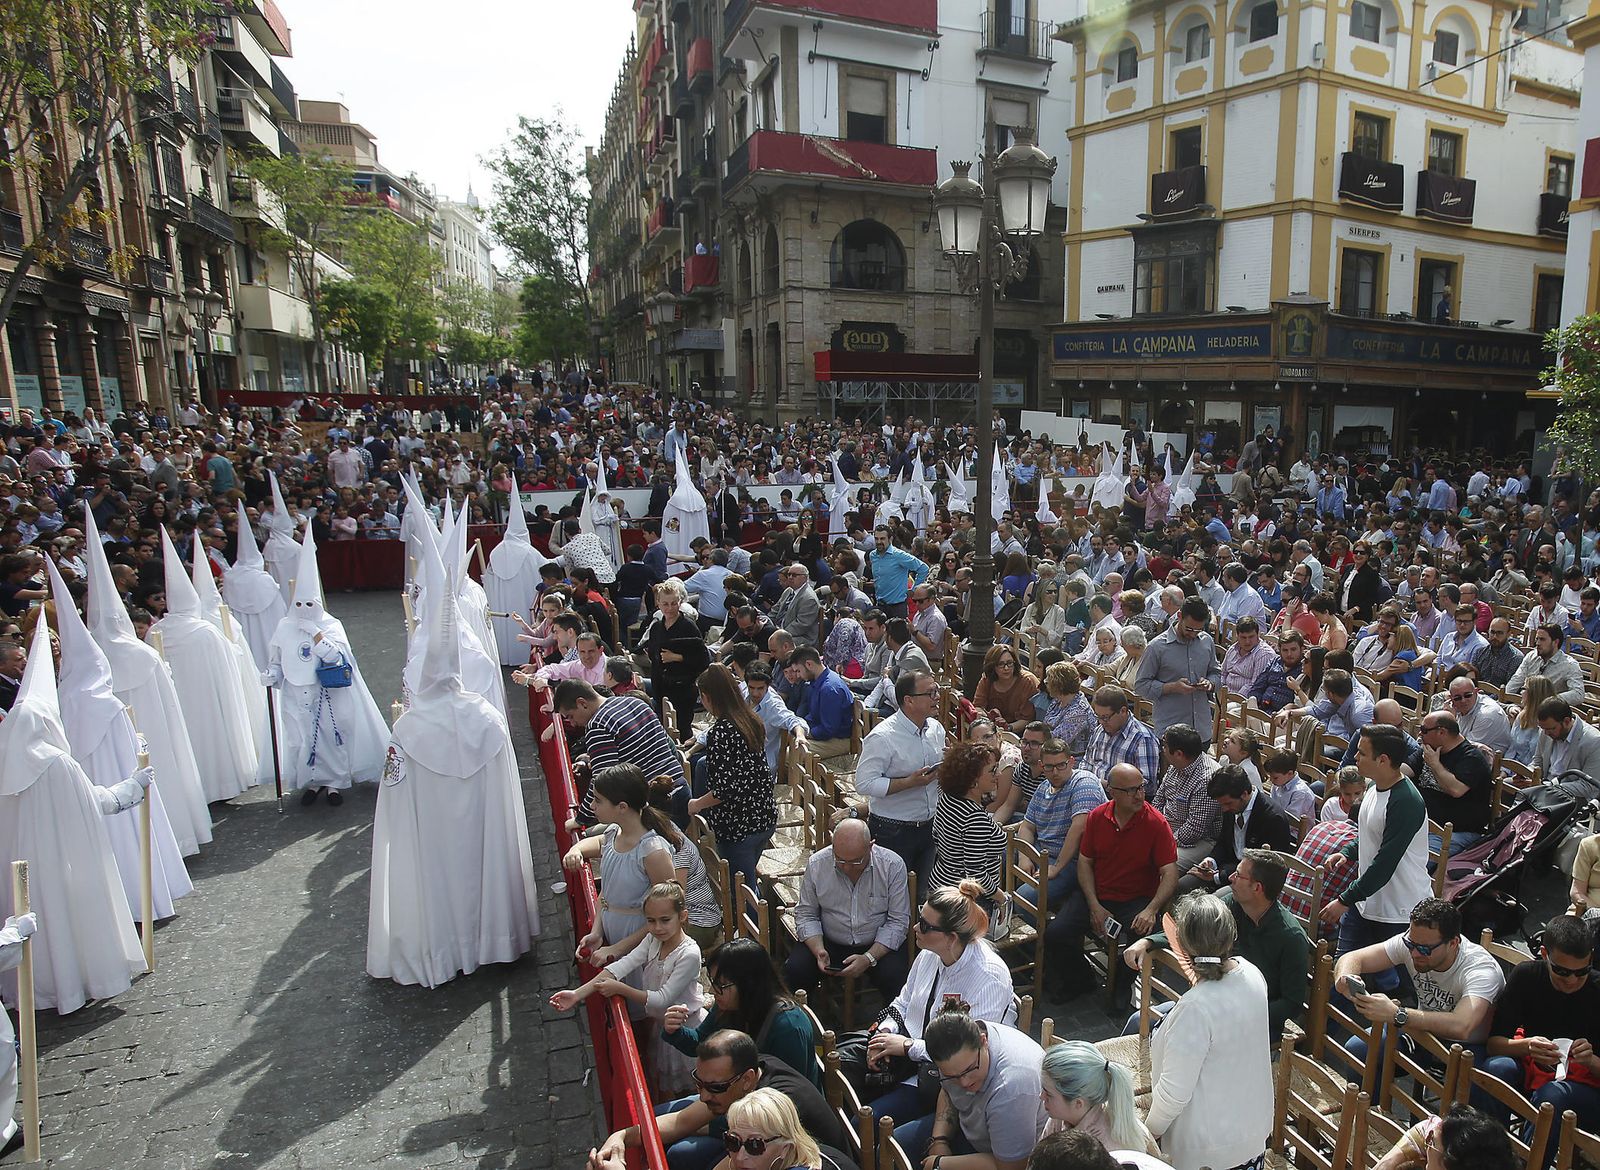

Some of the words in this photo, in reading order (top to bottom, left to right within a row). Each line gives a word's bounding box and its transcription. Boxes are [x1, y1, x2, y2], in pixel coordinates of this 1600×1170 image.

[1349, 226, 1381, 239] SIERPES
[1096, 283, 1126, 294] CAMPANA
[1064, 340, 1105, 352] CONFITERIA
[1112, 337, 1128, 354] LA
[1133, 335, 1196, 354] CAMPANA
[1207, 335, 1260, 349] HELADERIA
[1352, 338, 1406, 353] CONFITERIA
[1419, 340, 1441, 360] LA
[1455, 344, 1532, 366] CAMPANA
